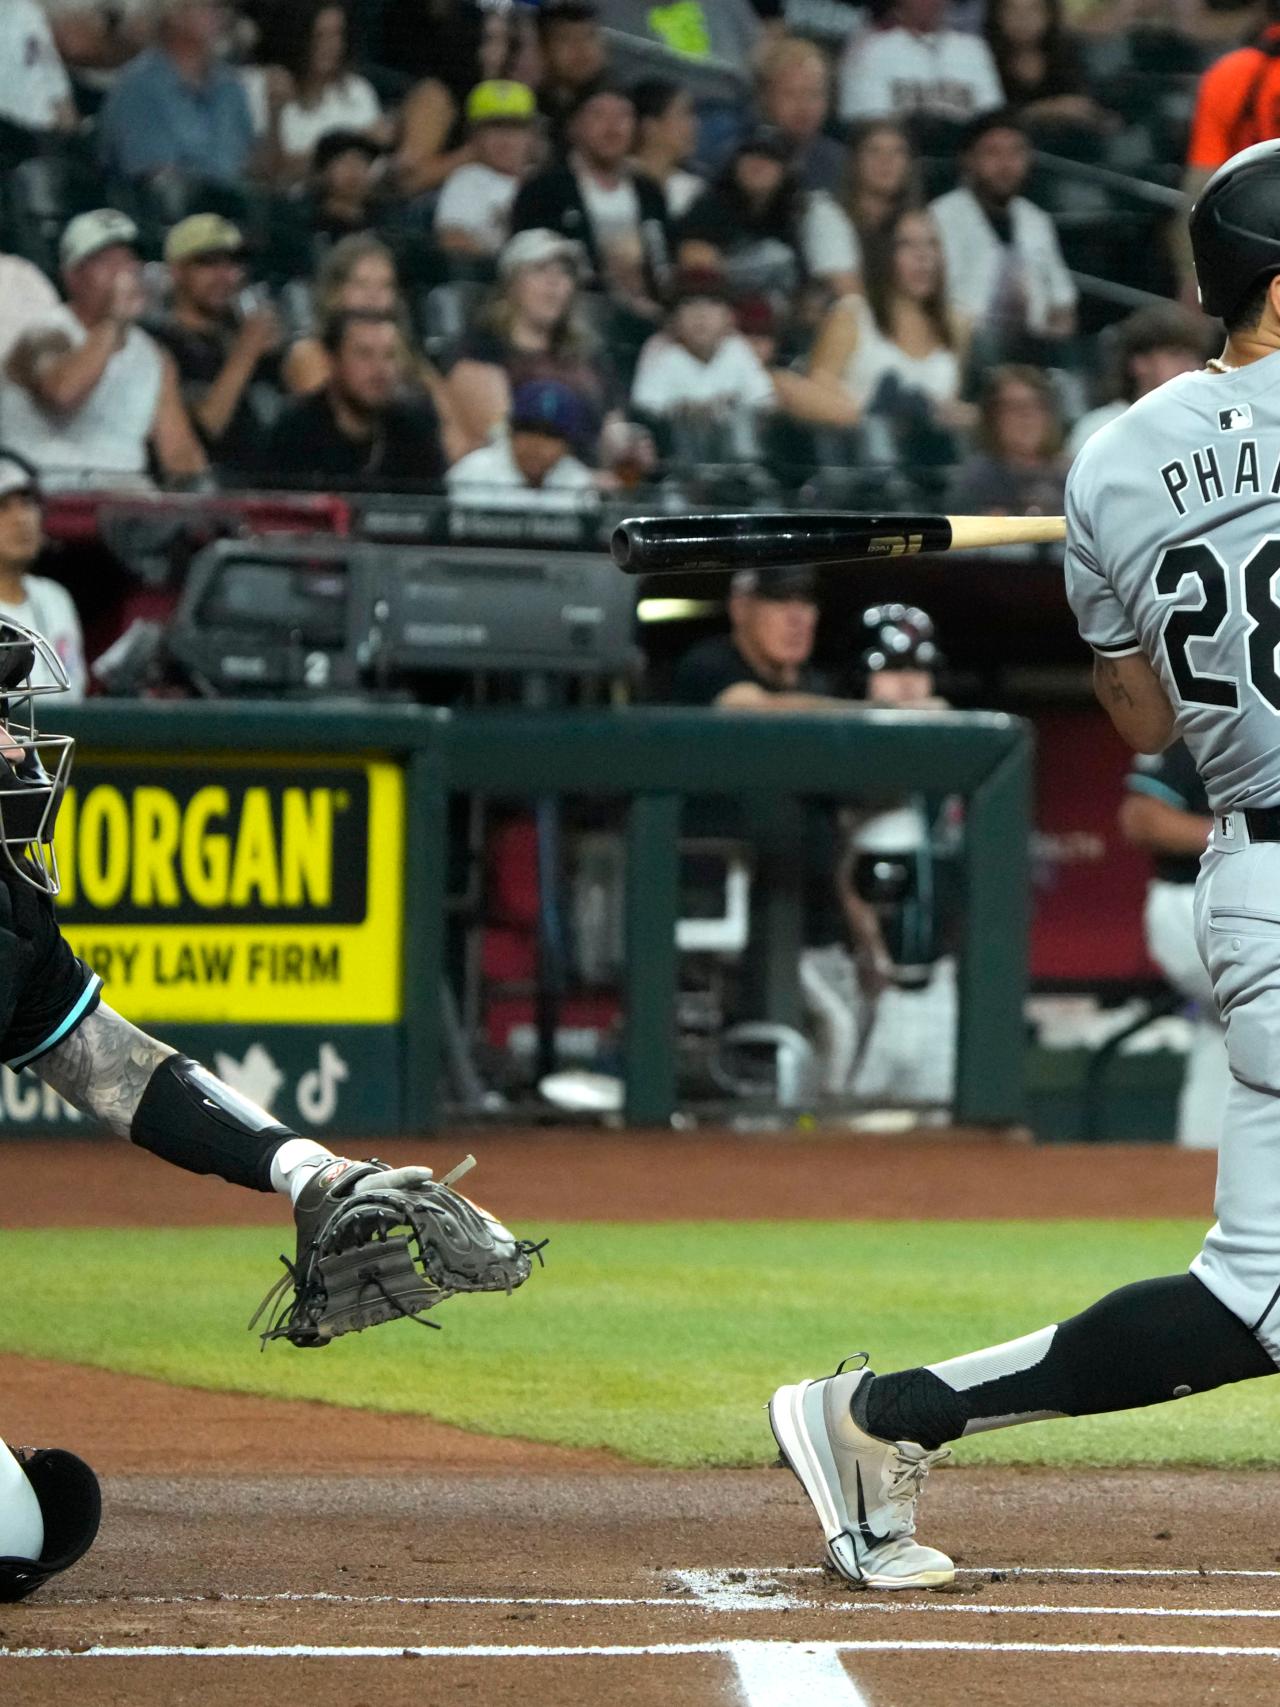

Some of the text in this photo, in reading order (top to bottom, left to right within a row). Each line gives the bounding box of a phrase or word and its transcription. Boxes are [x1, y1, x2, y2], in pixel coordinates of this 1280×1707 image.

[303, 650, 331, 687] 2
[153, 944, 234, 984] LAW
[247, 944, 342, 984] FIRM
